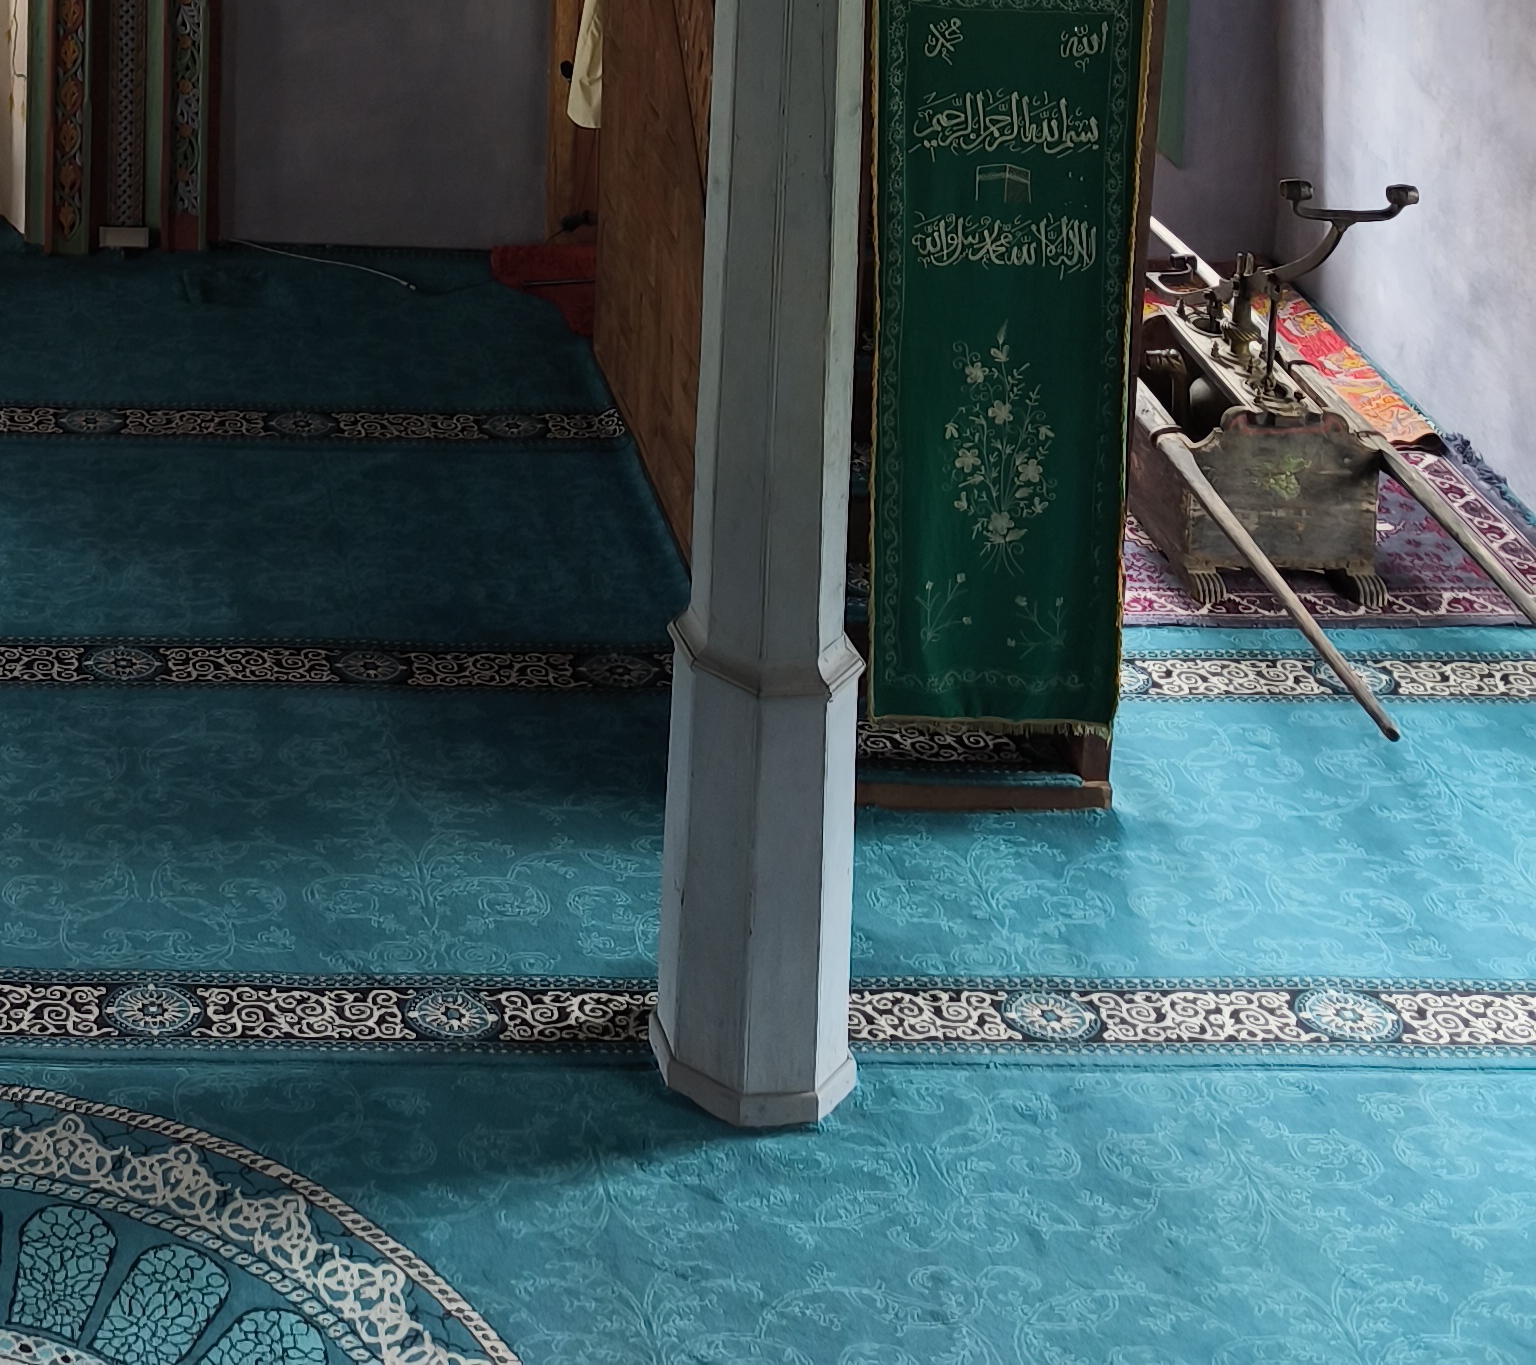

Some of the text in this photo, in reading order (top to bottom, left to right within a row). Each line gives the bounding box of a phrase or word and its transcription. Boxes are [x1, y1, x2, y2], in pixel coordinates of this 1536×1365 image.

[924, 17, 1109, 58] الله محمد
[914, 91, 984, 149] الرحيم
[1043, 116, 1099, 154] بسم
